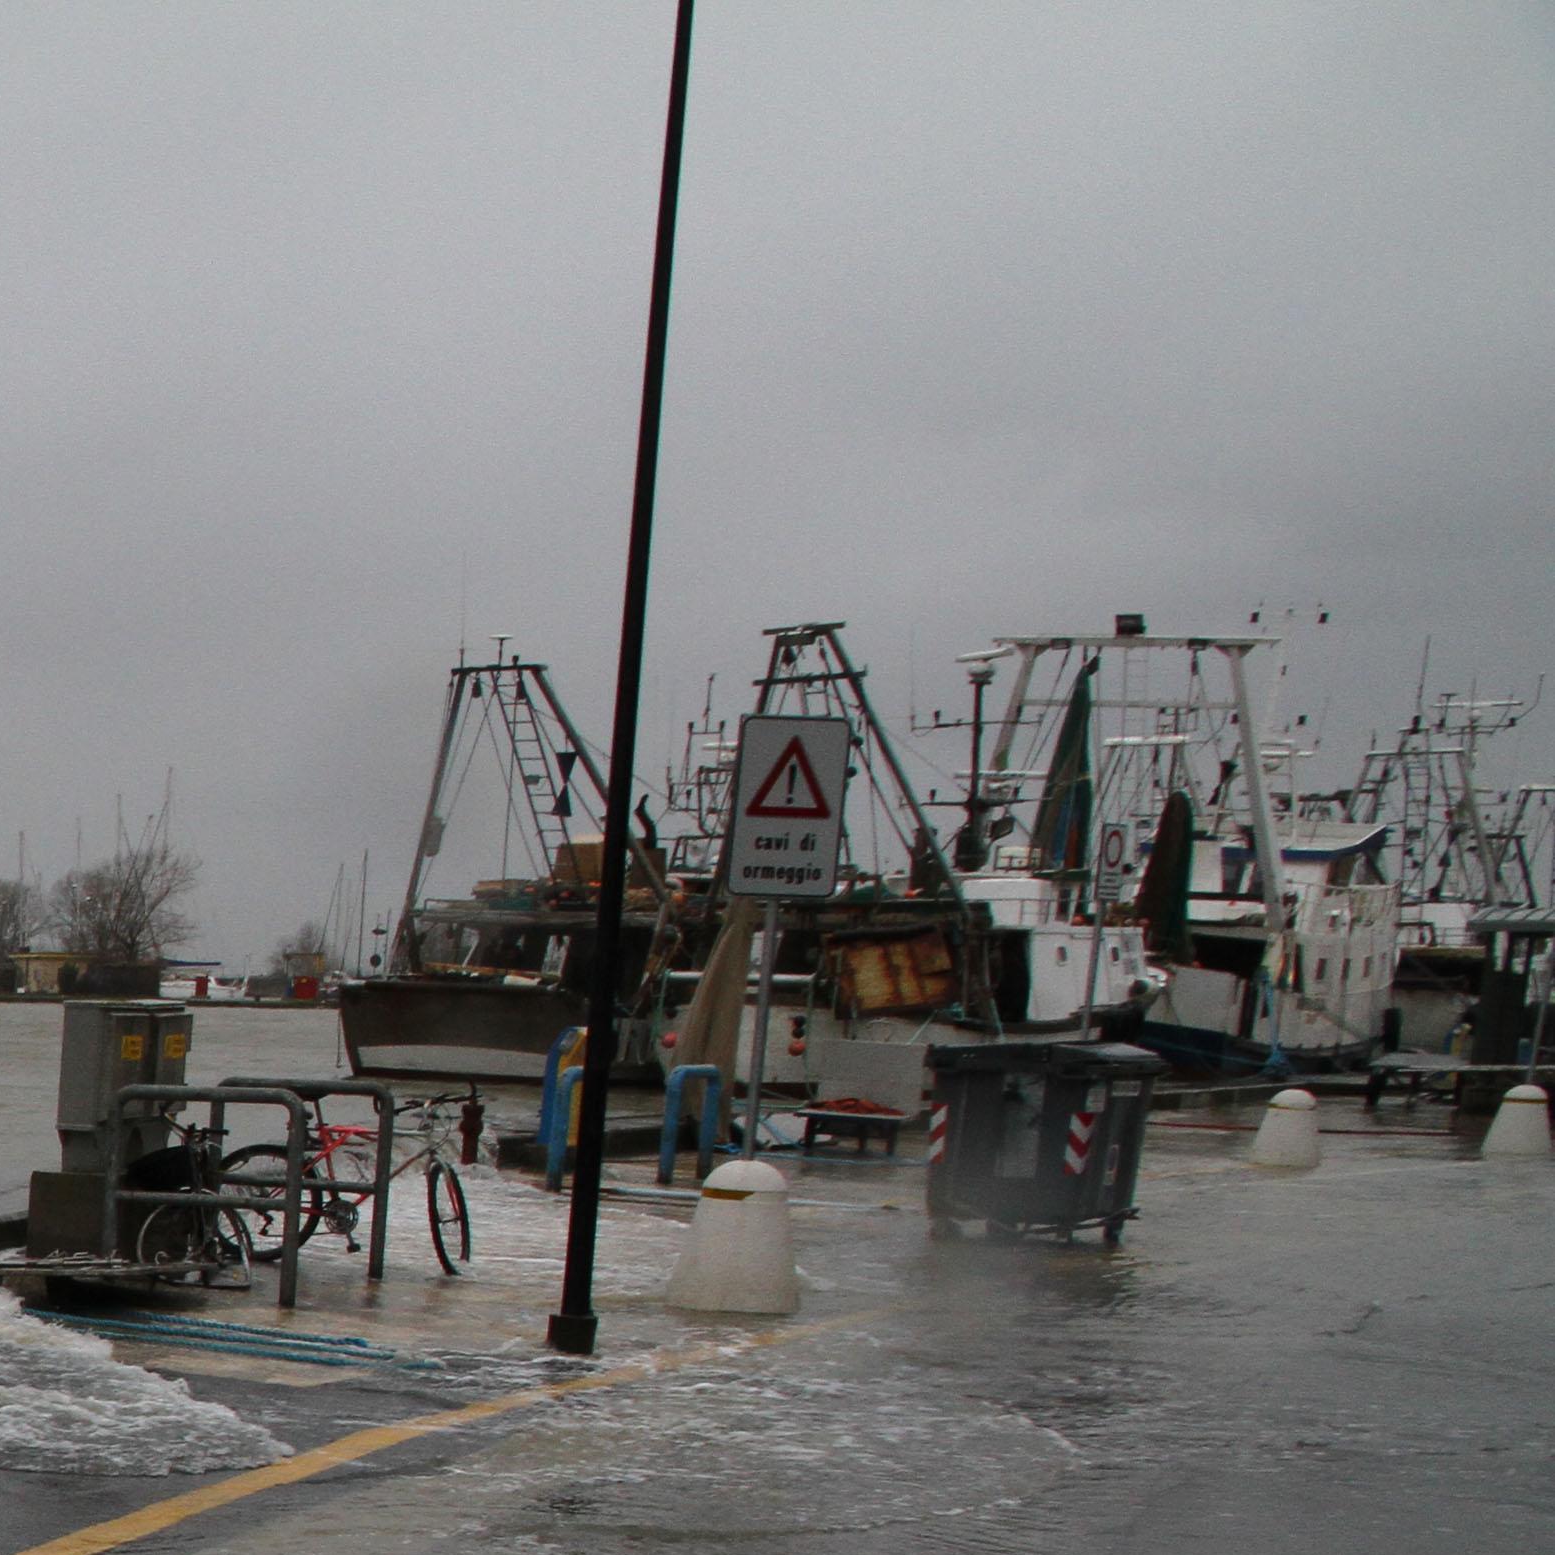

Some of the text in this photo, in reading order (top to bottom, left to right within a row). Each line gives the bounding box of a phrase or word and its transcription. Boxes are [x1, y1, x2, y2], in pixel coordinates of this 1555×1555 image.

[755, 832, 816, 851] cavi di
[743, 863, 822, 885] ormeggio
